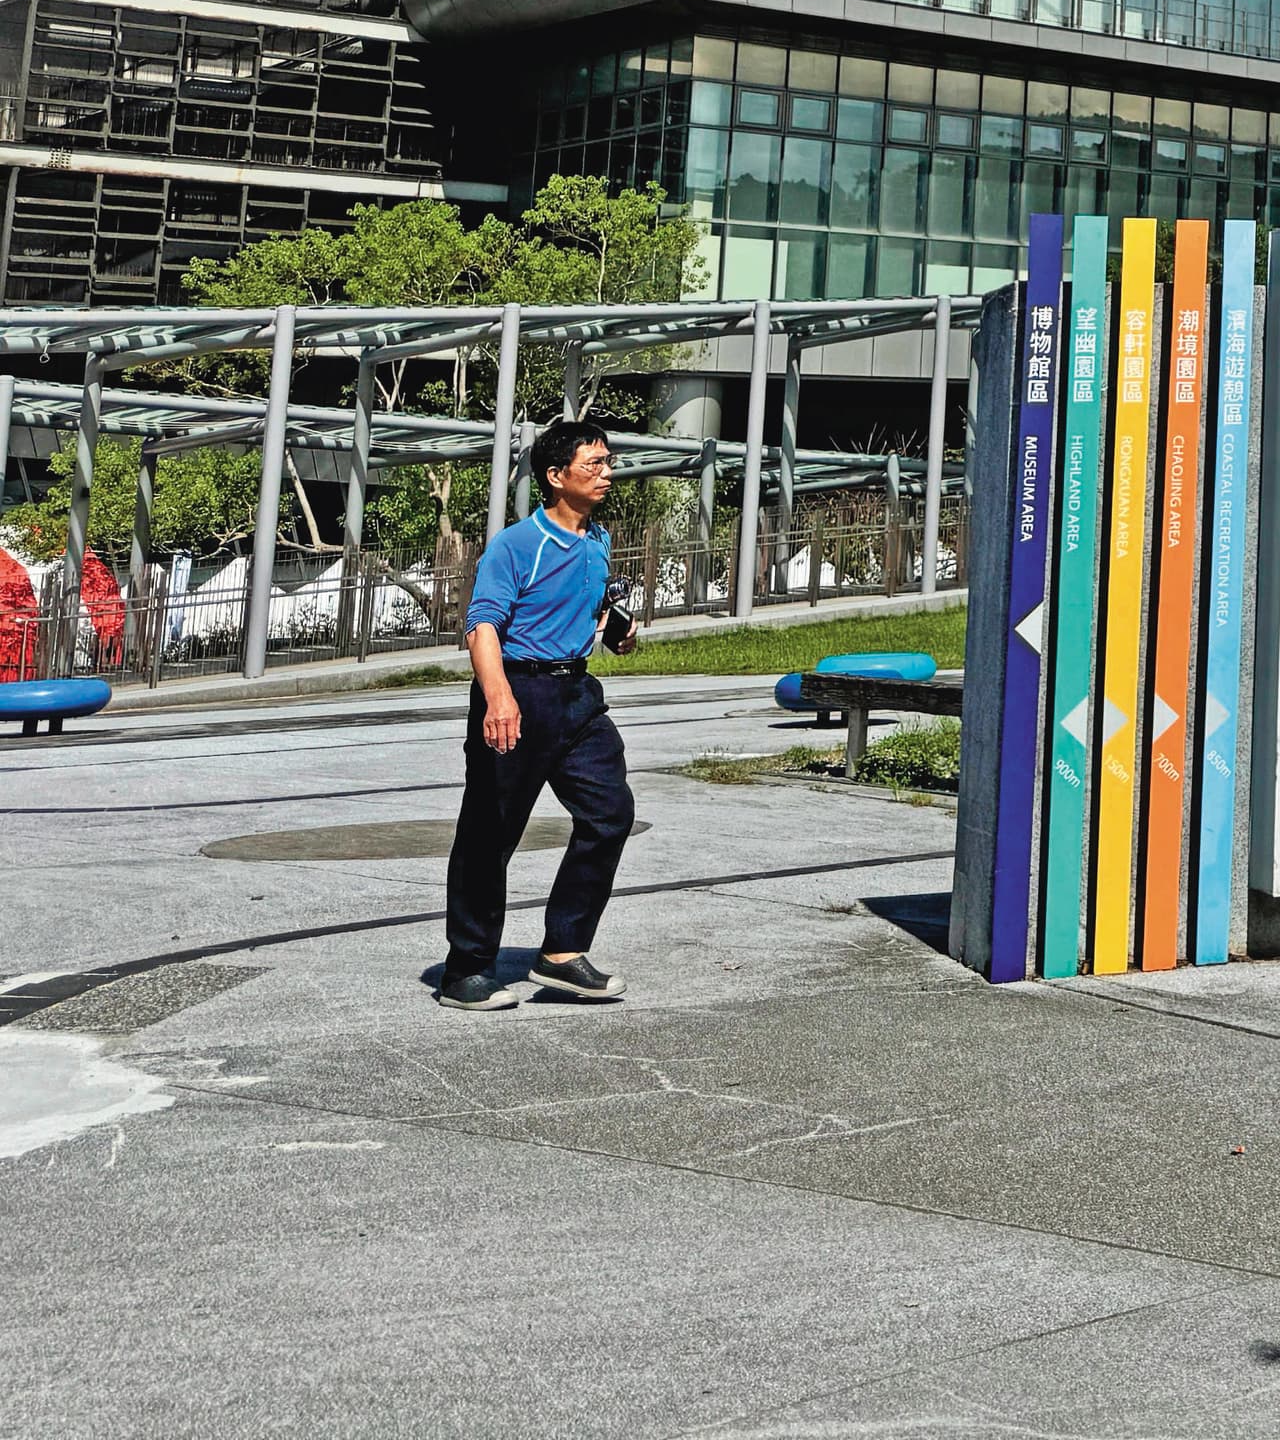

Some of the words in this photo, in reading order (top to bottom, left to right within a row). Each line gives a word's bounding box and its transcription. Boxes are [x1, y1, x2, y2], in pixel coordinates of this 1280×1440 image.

[1027, 306, 1054, 403] 博物館區
[1073, 307, 1098, 403] 望幽園區
[1122, 309, 1147, 403] 容軒園區
[1175, 309, 1200, 403] 潮境園區
[1223, 310, 1247, 426] 濱海遊憩區
[1022, 435, 1038, 501] MUSEUM
[1067, 435, 1084, 511] HIGHLAND
[1118, 434, 1134, 518] RONGXUAN
[1169, 435, 1185, 508] CHAOJING
[1219, 433, 1234, 497] COASTAL
[1020, 503, 1035, 542] AREA
[1066, 514, 1080, 553] AREA
[1116, 520, 1130, 559] AREA
[1167, 510, 1182, 548] AREA
[1216, 499, 1232, 586] RECREATION
[1215, 589, 1230, 628] AREA
[1055, 758, 1081, 789] 900m
[1153, 752, 1181, 782] 700m
[1206, 750, 1233, 779] 850m
